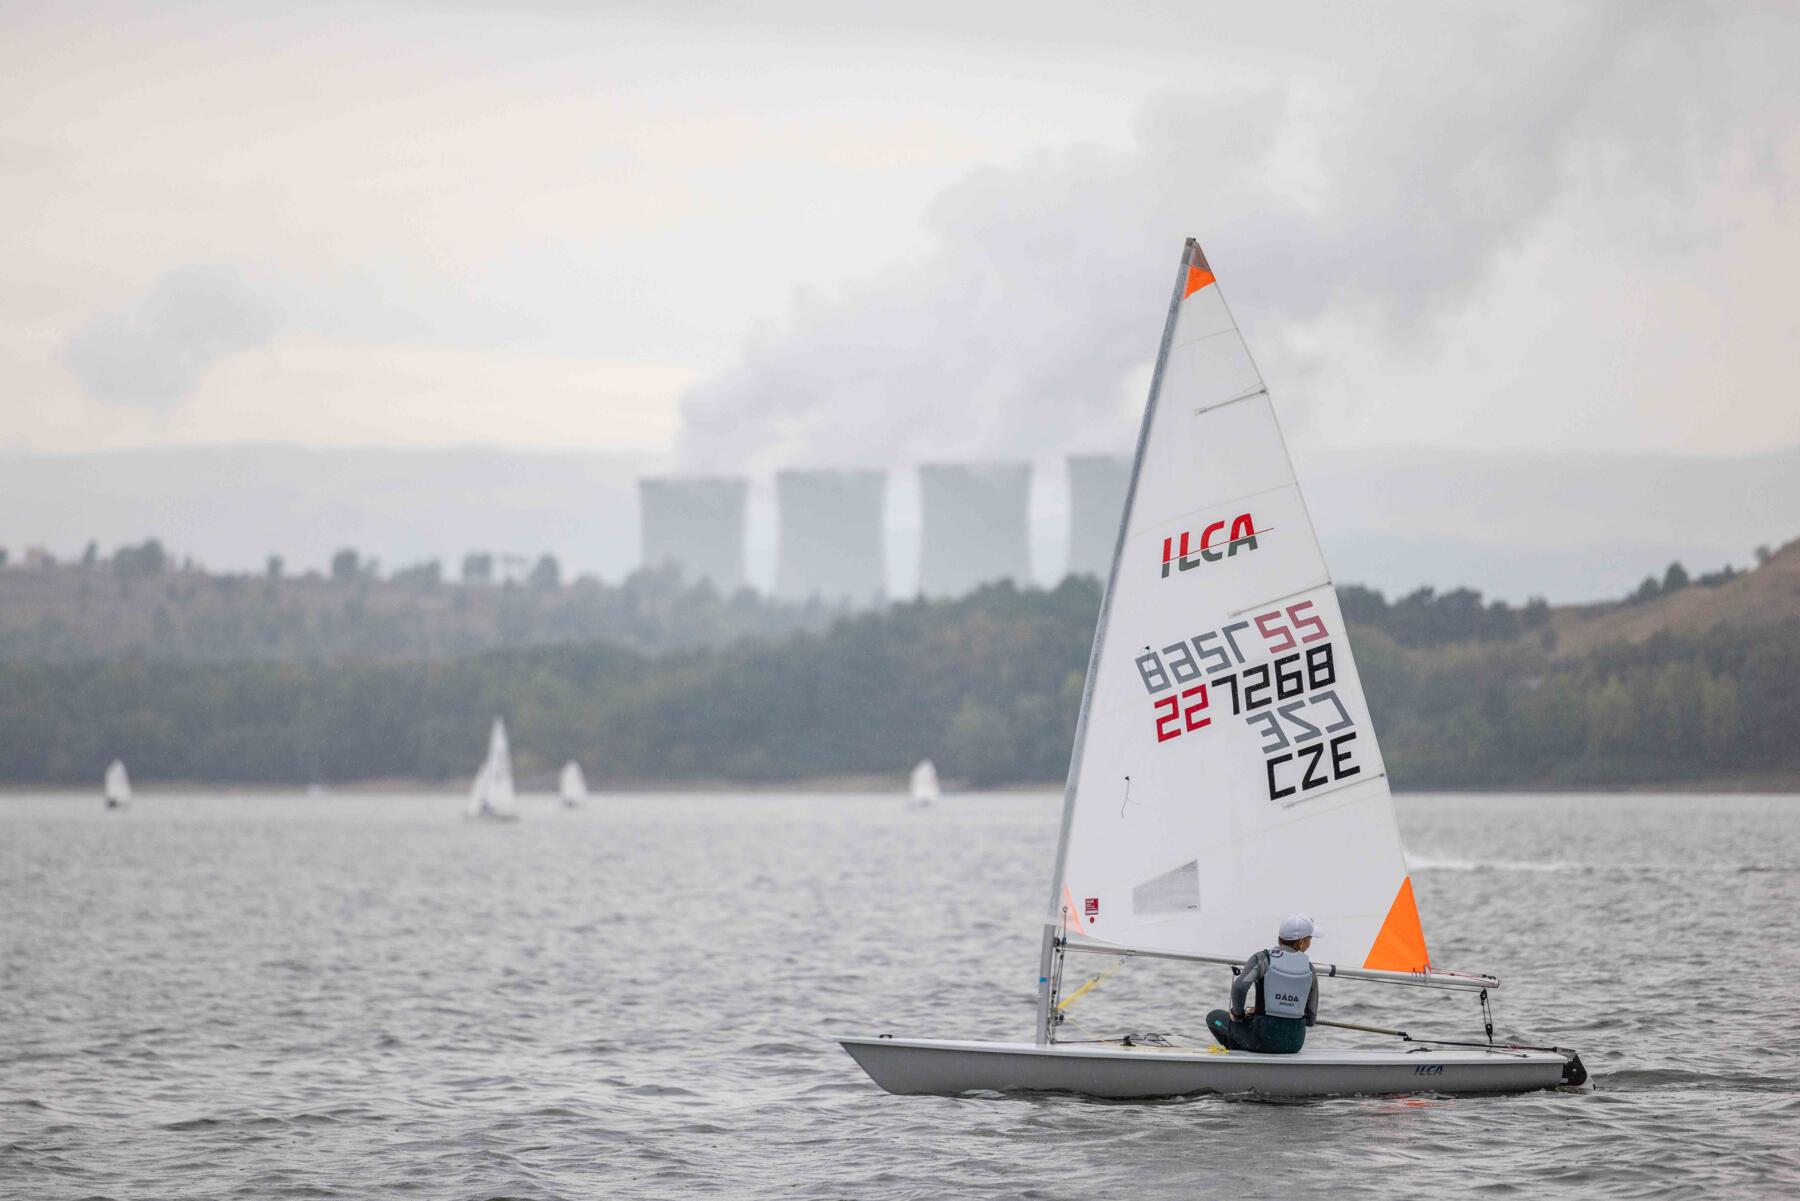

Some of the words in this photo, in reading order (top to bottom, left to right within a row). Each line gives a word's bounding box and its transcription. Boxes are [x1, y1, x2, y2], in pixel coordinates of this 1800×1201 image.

[1161, 513, 1258, 579] ILCA
[1154, 642, 1337, 743] 227268
[1266, 731, 1361, 801] CZE
[1413, 1065, 1443, 1076] ILCA
